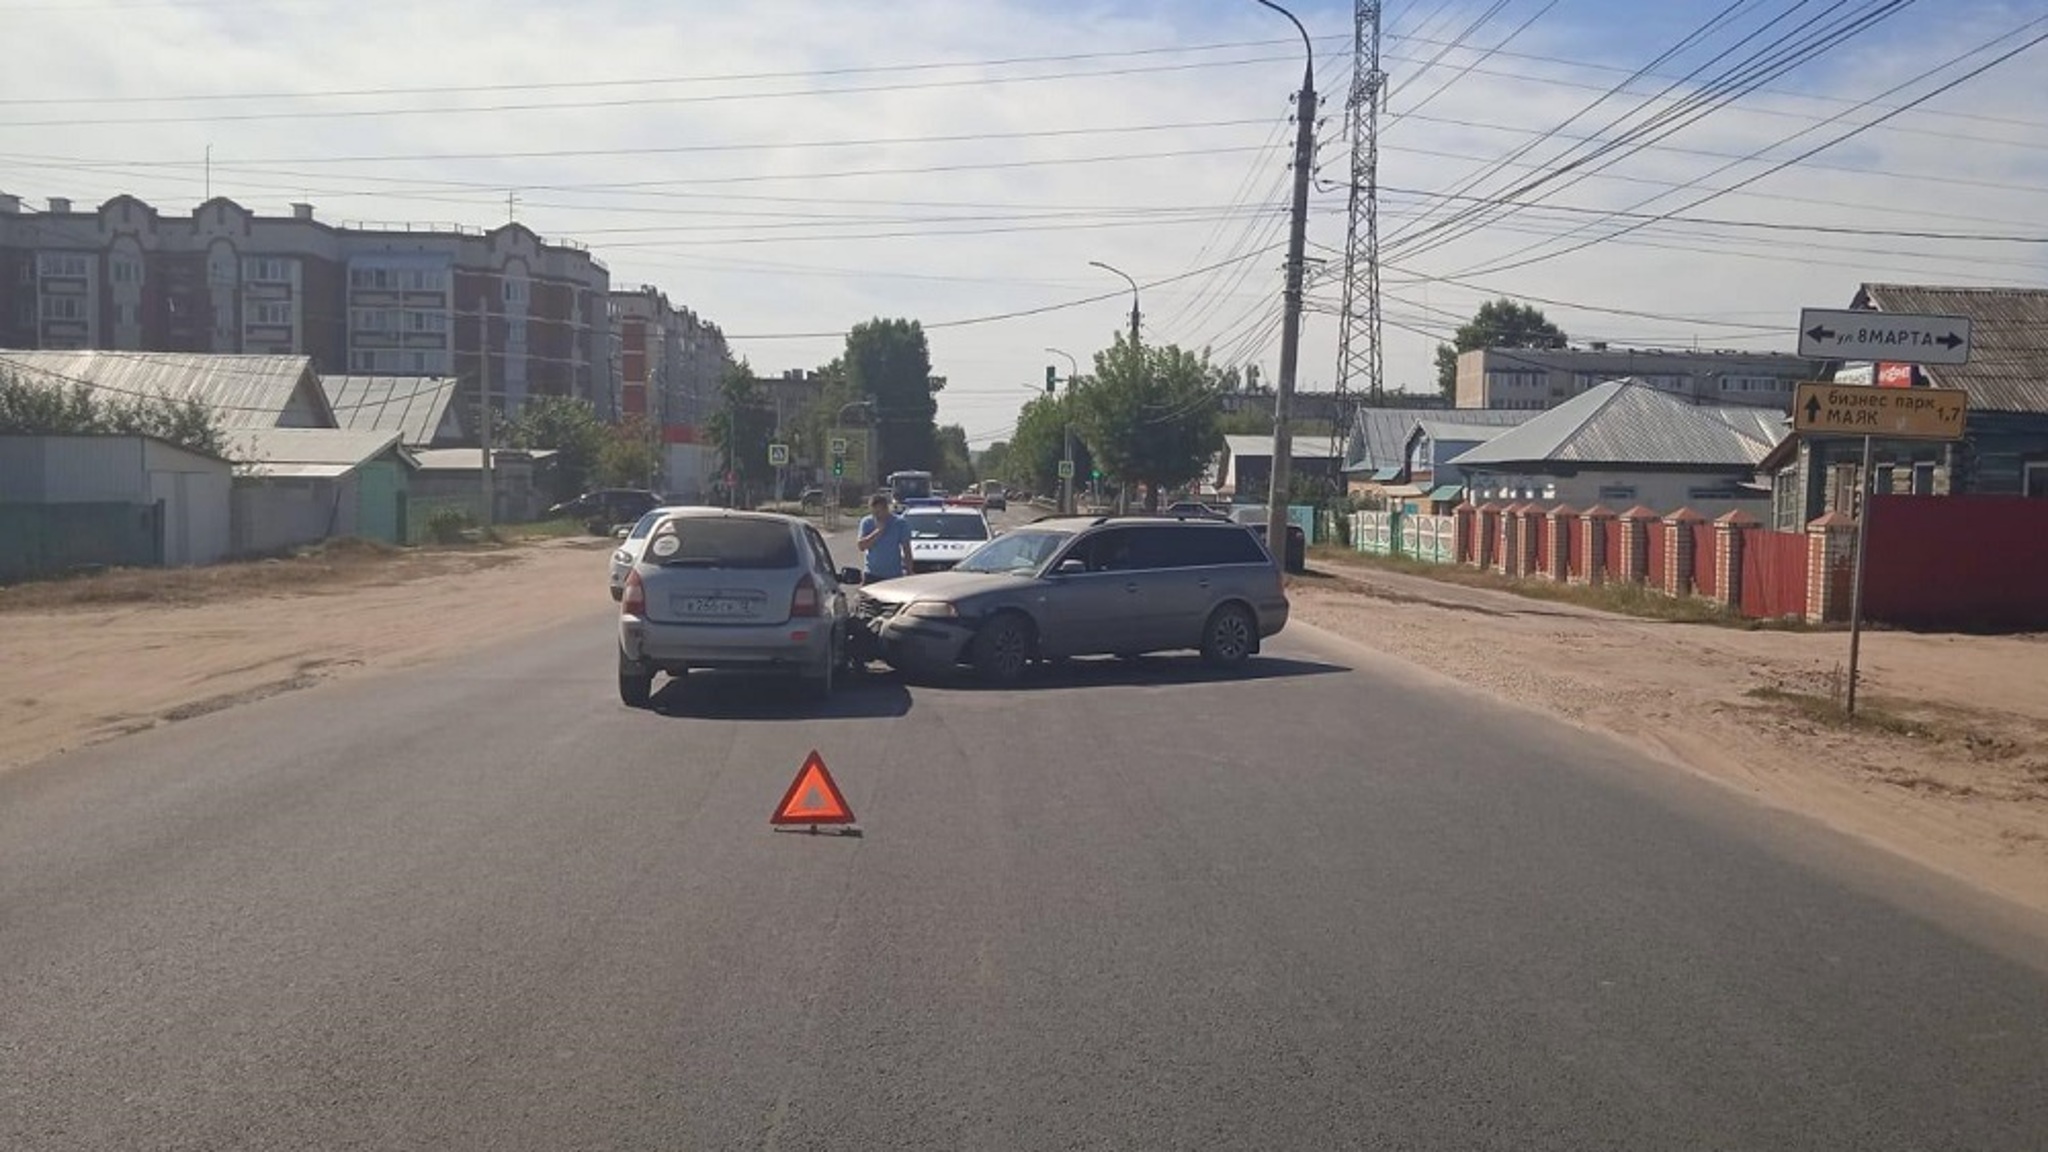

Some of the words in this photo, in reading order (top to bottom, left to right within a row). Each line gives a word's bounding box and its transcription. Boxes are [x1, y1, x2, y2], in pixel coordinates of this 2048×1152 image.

[1828, 389, 1888, 407] бизнес
[1895, 396, 1934, 412] парк
[1826, 408, 1879, 425] МАЯК
